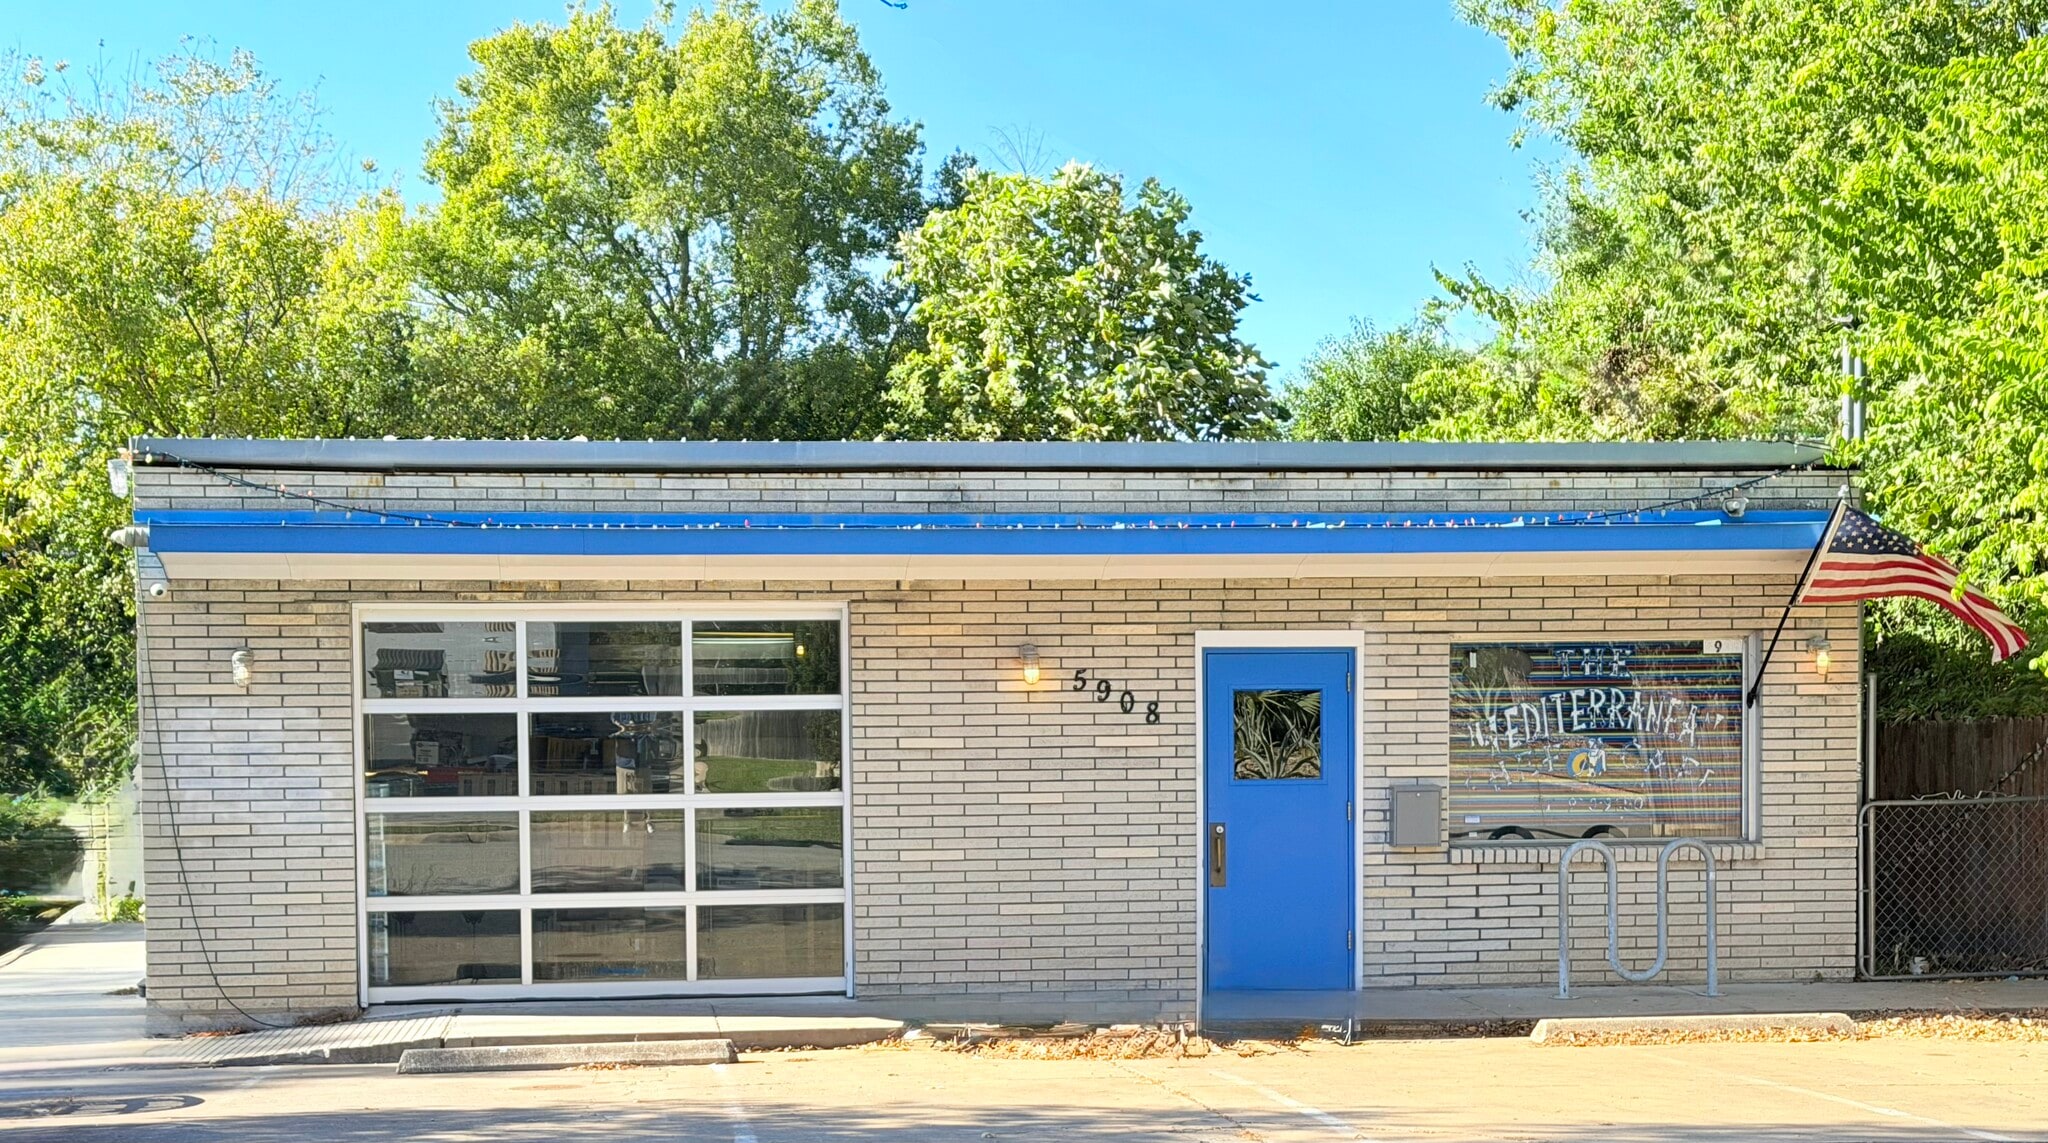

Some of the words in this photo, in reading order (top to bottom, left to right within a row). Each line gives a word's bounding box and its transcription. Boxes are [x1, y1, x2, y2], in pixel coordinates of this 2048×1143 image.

[1714, 640, 1722, 653] 9
[1556, 648, 1632, 677] THE
[1073, 668, 1160, 724] 5908
